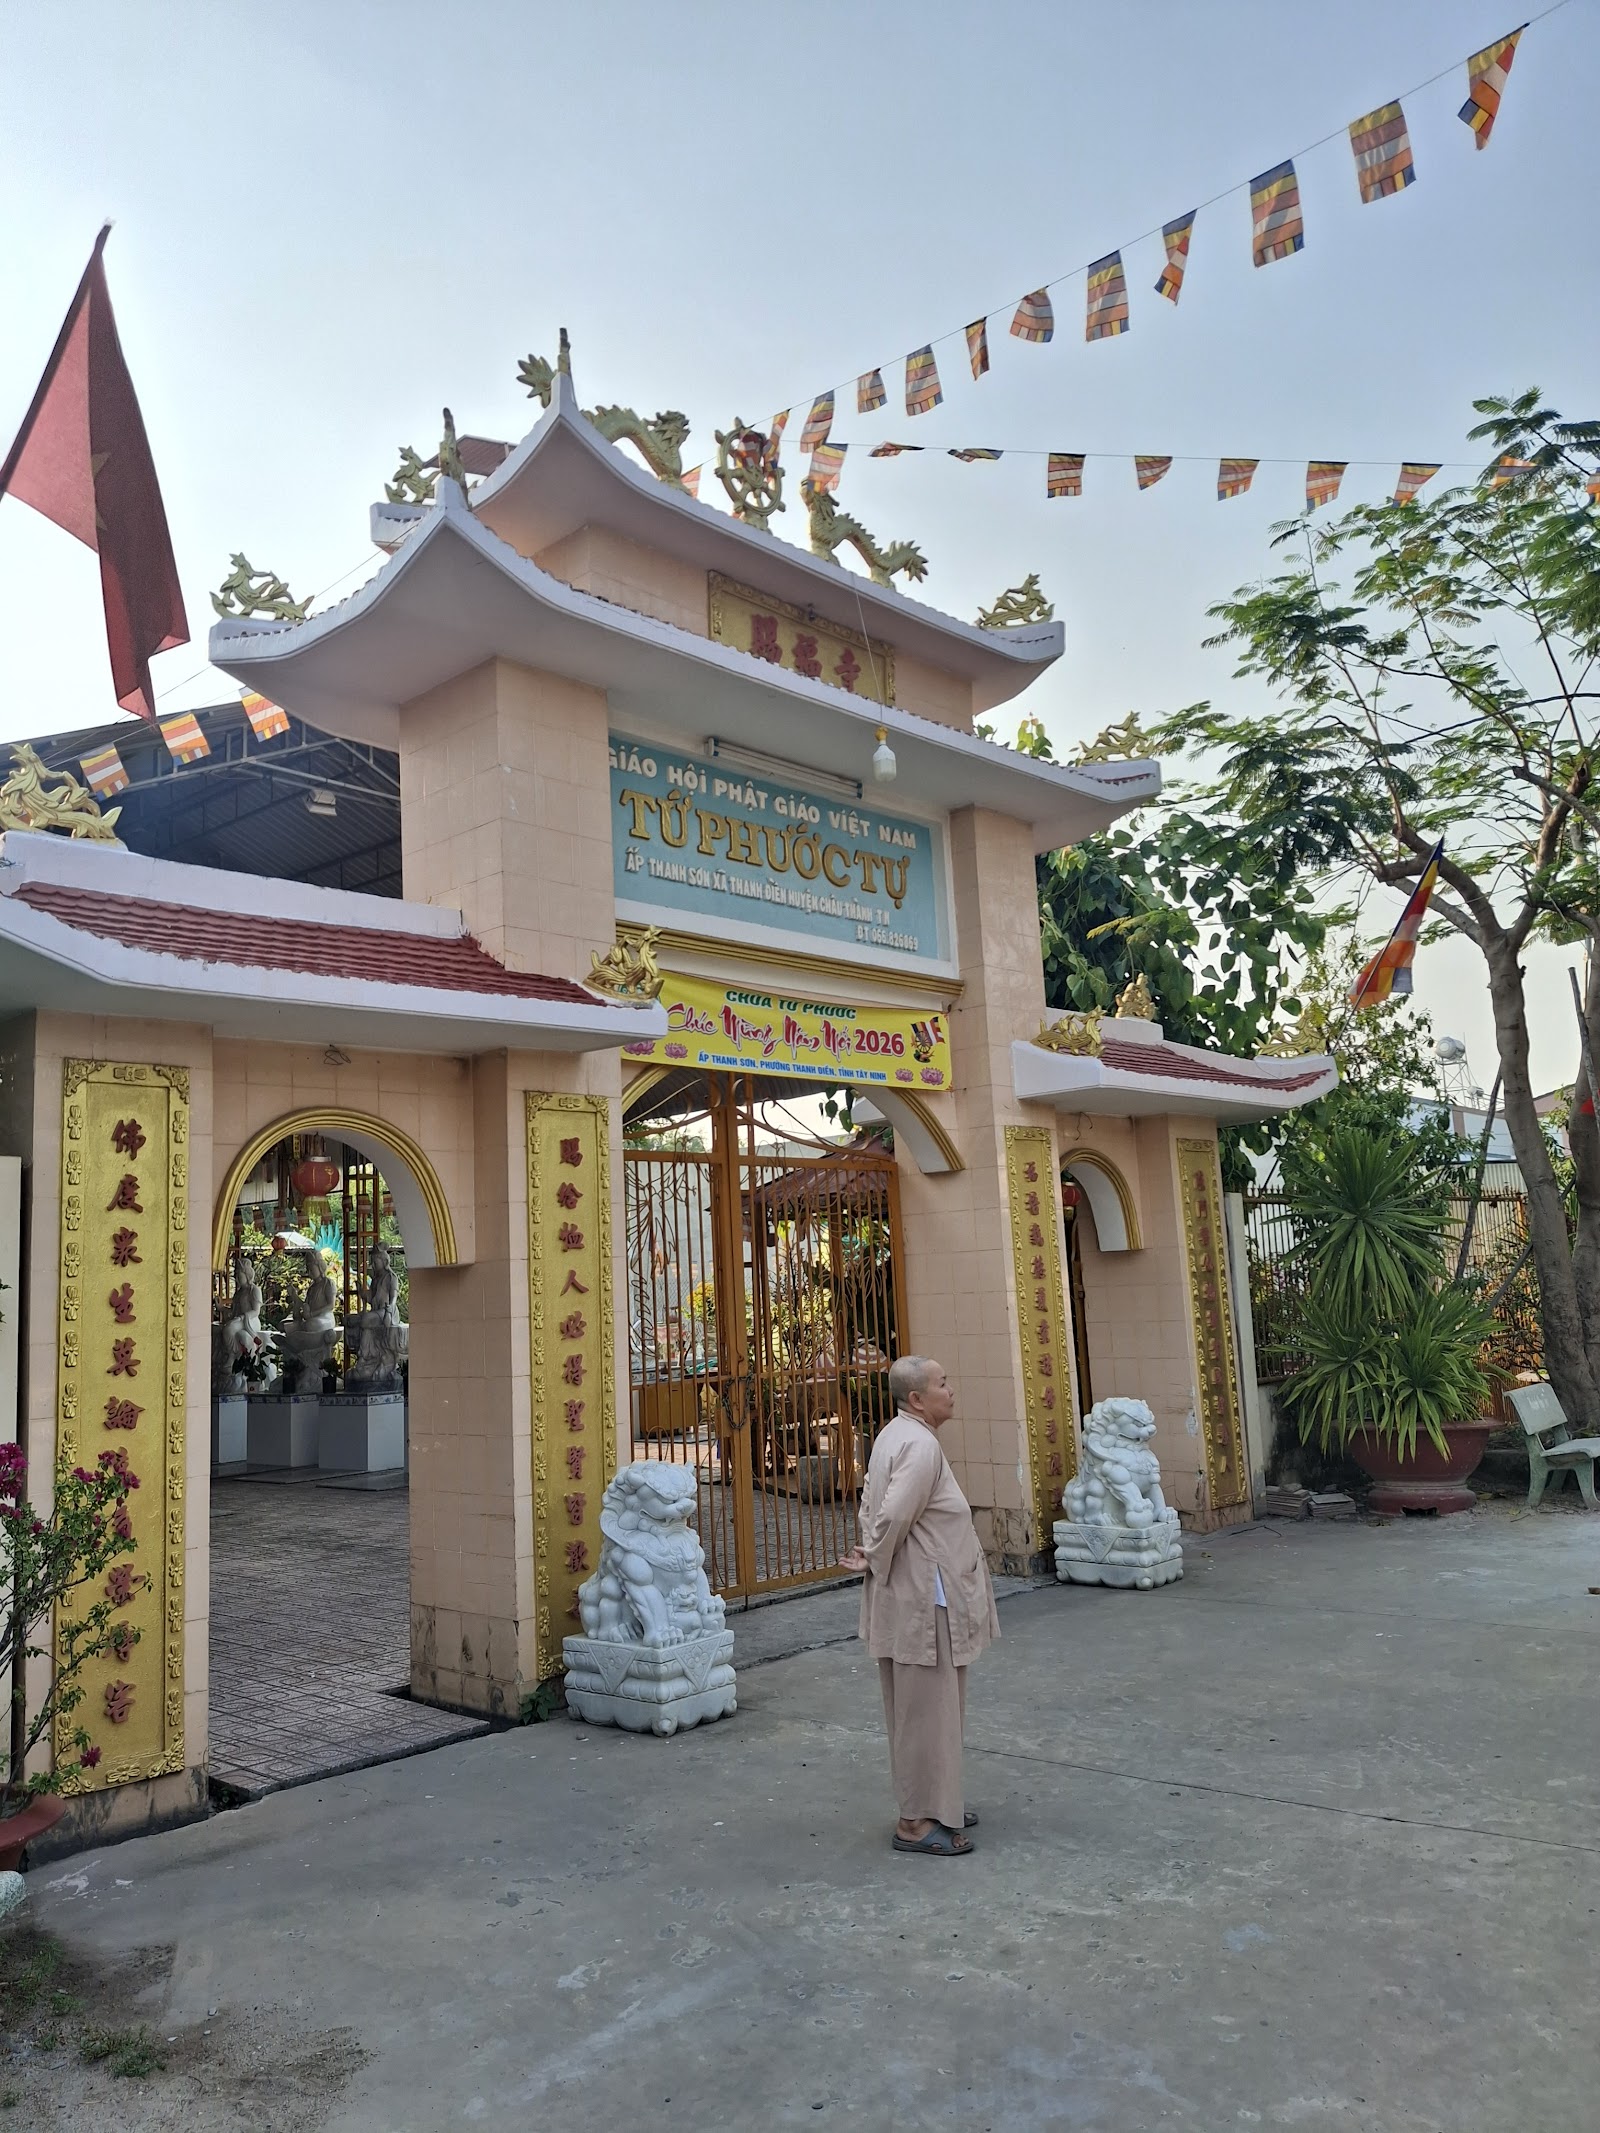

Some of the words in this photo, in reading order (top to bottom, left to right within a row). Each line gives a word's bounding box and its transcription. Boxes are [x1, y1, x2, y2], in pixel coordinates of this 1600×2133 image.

[714, 781, 768, 811] PHẬT
[879, 825, 916, 849] NAM
[648, 858, 687, 883] THANH
[729, 877, 763, 899] THANH
[696, 808, 851, 887] PHƯỚC
[854, 850, 911, 909] TỰ
[667, 1003, 717, 1034] Chúc
[719, 1004, 779, 1057] Mừng
[854, 1028, 905, 1056] 2026
[712, 1054, 738, 1066] THANH
[792, 1063, 817, 1074] THANH
[869, 1071, 887, 1081] NINH
